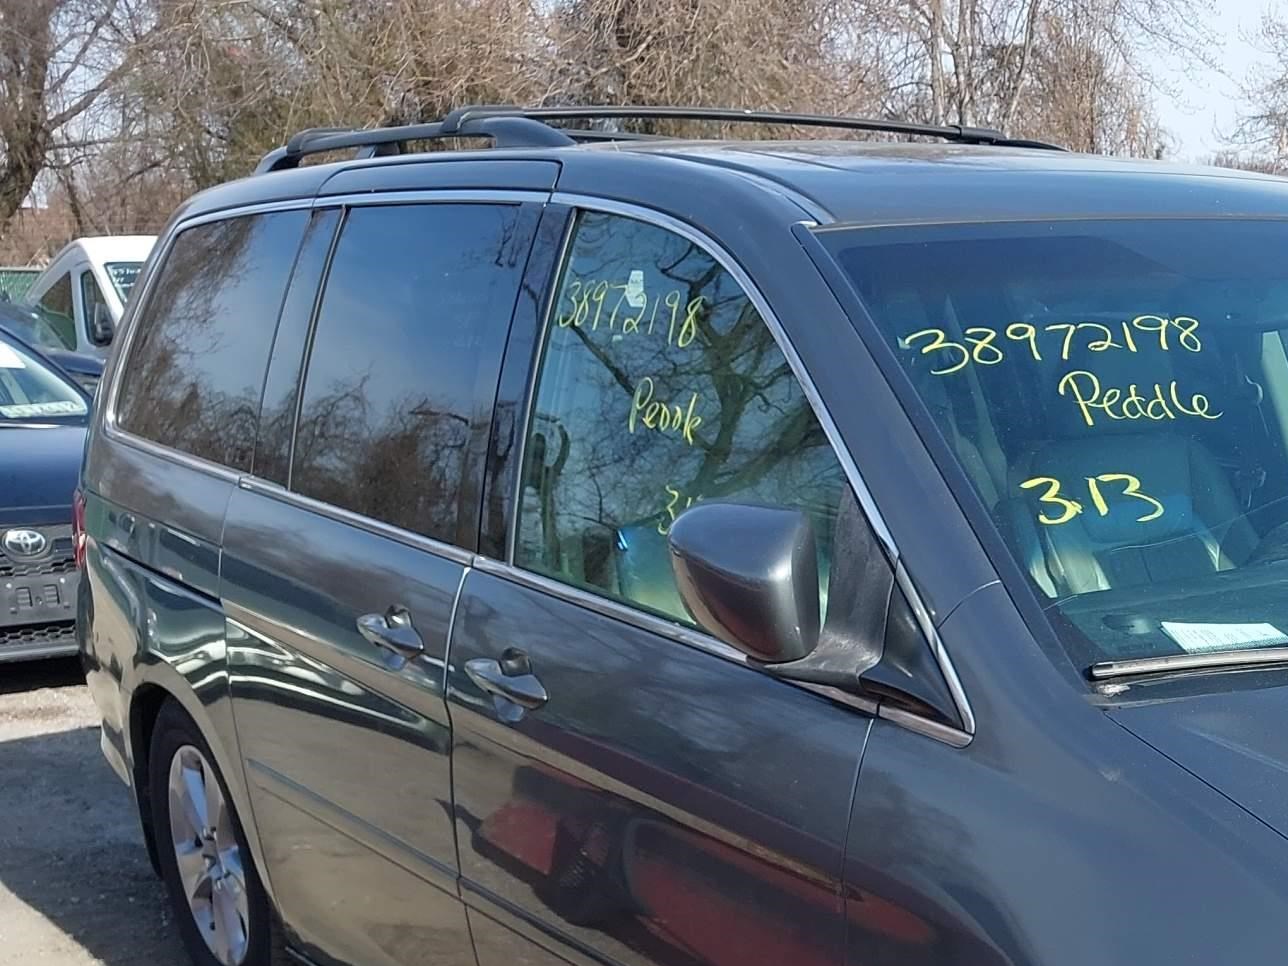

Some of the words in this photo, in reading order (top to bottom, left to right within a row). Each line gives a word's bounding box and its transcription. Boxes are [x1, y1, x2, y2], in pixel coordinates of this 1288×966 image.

[559, 280, 708, 348] 38972198
[905, 313, 1203, 376] 38972198
[1057, 370, 1224, 427] Peddle
